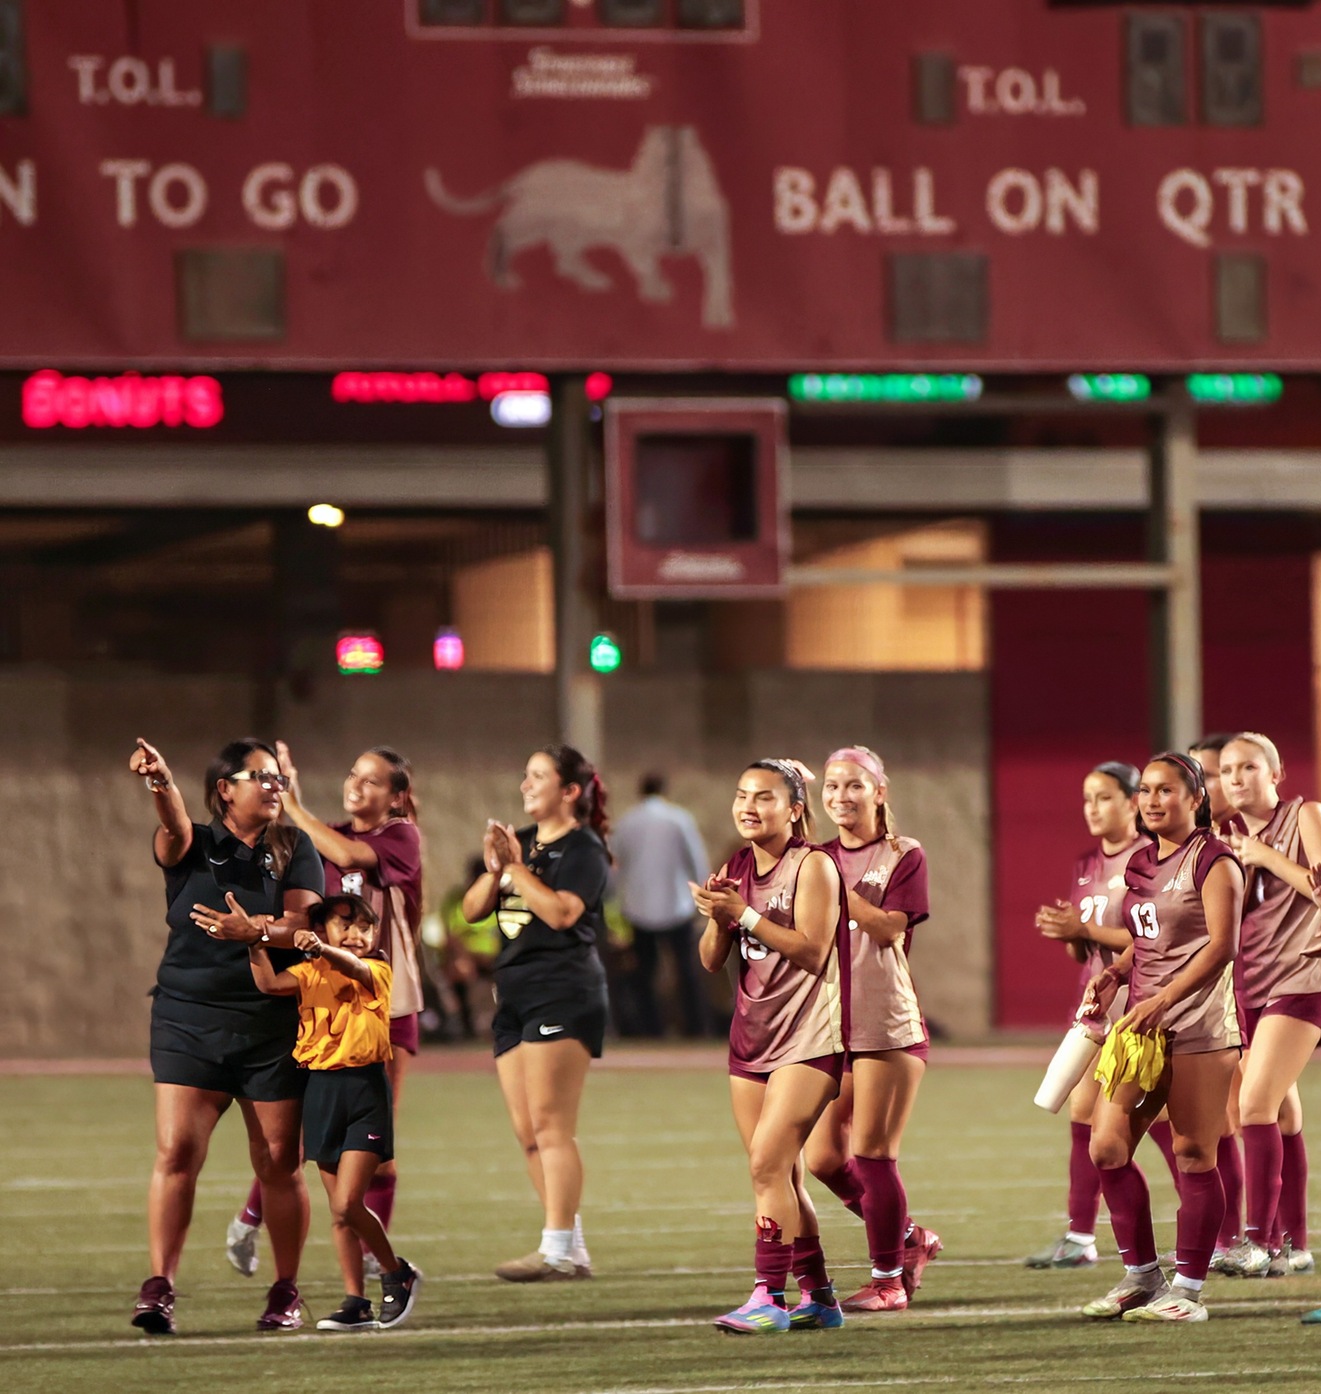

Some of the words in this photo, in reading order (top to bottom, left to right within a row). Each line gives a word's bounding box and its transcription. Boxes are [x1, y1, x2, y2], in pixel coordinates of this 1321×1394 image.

[69, 56, 201, 106] T.O.L.
[958, 66, 1085, 115] T.O.L.
[100, 160, 207, 228] TO
[242, 163, 358, 230] GO
[774, 167, 955, 235] BALL
[987, 168, 1098, 235] ON
[1158, 168, 1307, 248] QTR
[1130, 902, 1160, 939] 13
